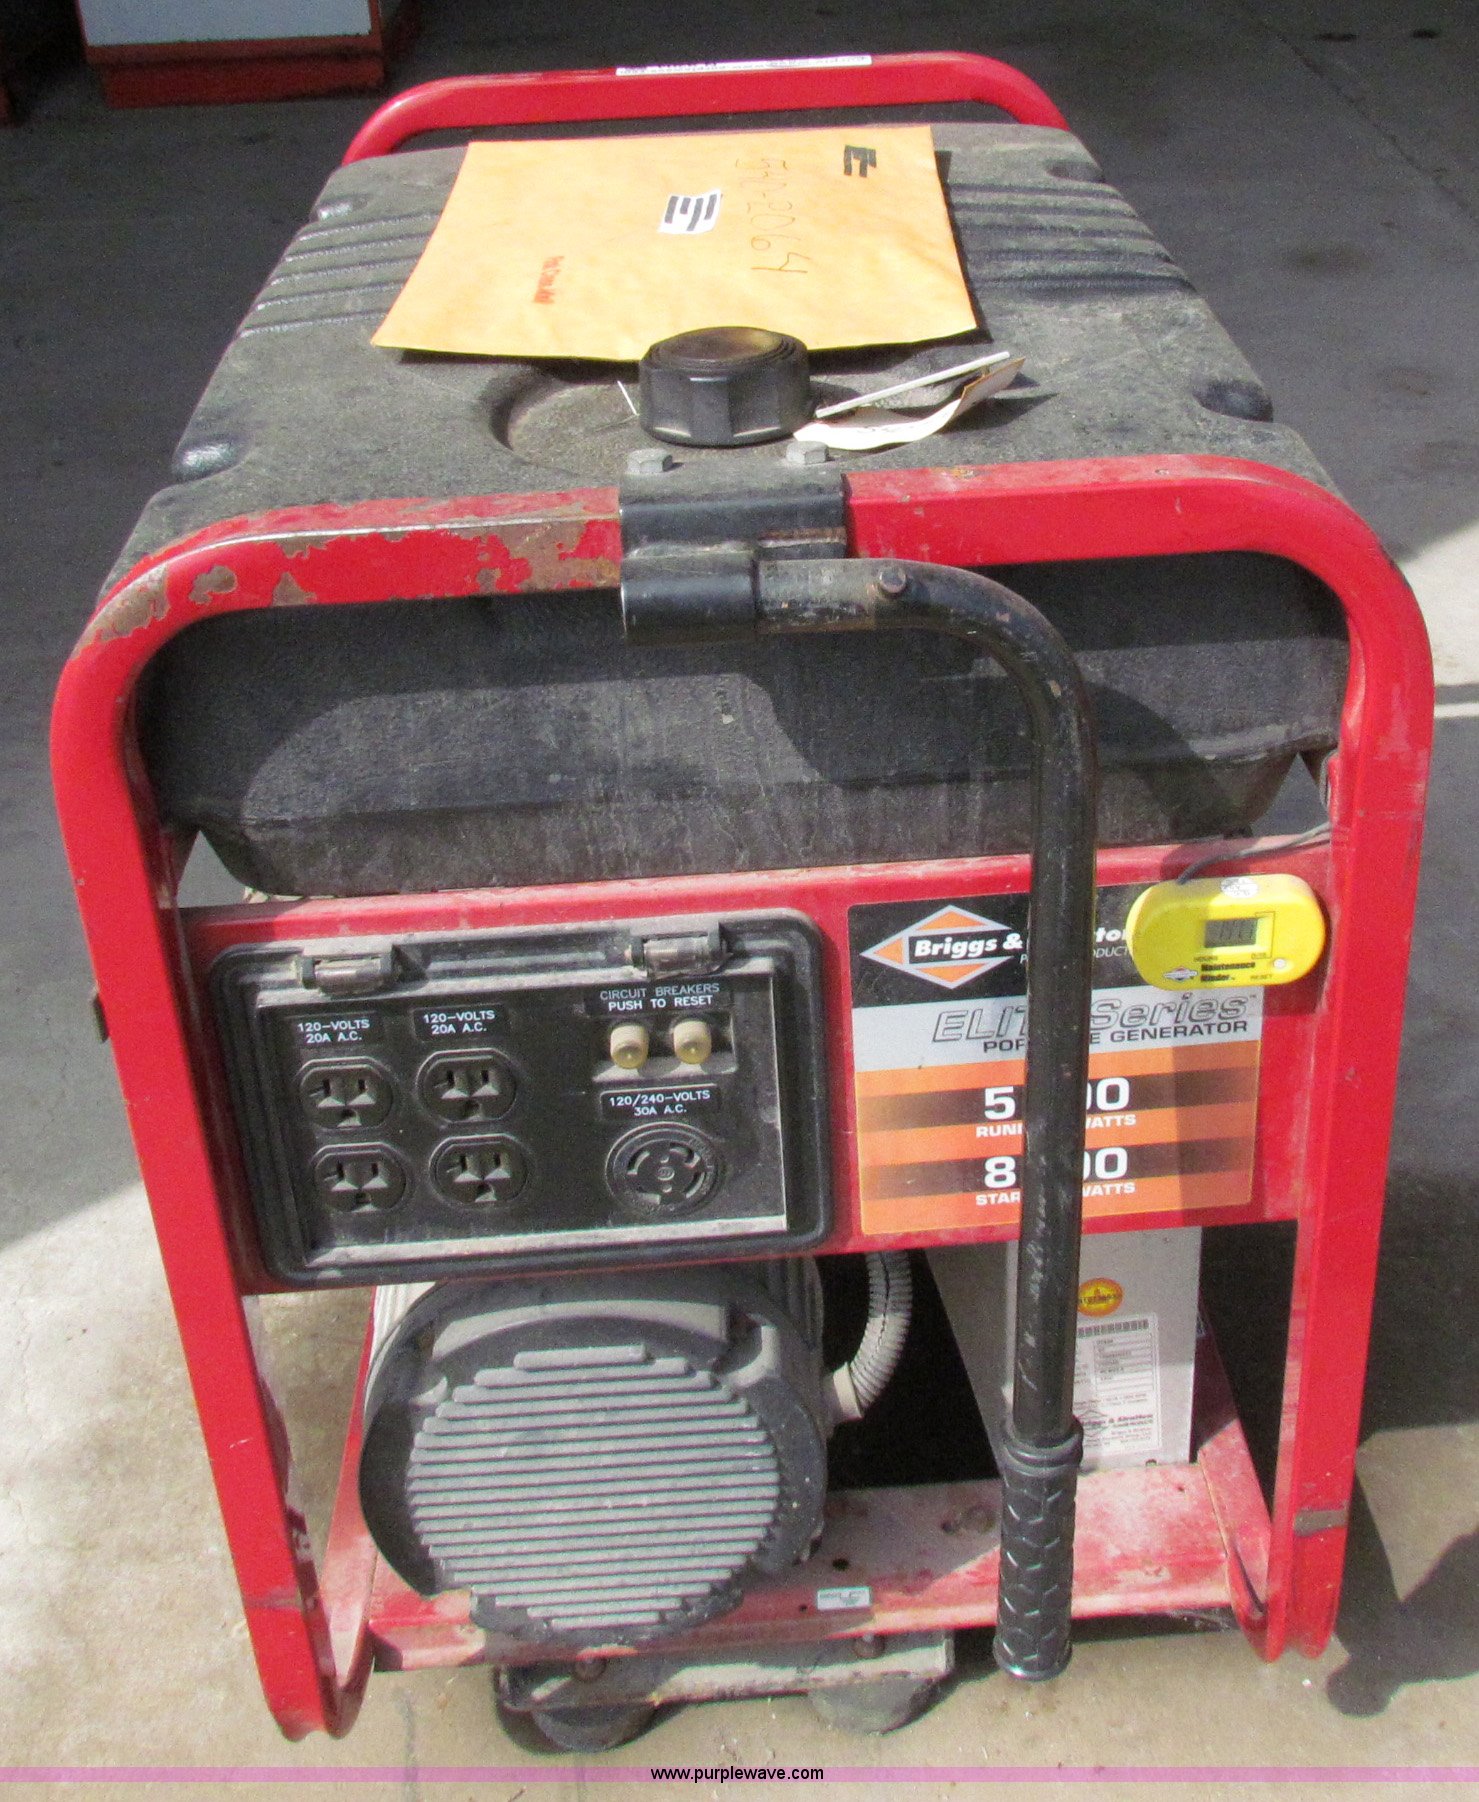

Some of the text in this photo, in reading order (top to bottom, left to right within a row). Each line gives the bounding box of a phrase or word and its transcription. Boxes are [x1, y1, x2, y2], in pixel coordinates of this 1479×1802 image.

[914, 937, 998, 959] Briggs
[1002, 932, 1024, 950] &
[600, 982, 720, 1001] CIRCUIT BREAKERS
[608, 995, 713, 1012] PUSH TO RESET
[1091, 992, 1249, 1031] Series
[423, 1010, 497, 1024] 120-VOLTS
[297, 1019, 371, 1033] 120-VOLTS
[431, 1021, 488, 1035] 20A A.C.
[1110, 1020, 1248, 1043] GENERATOR
[306, 1031, 362, 1044] 20A A.C.
[609, 1090, 711, 1107] 120/240-VOLTS
[634, 1103, 687, 1117] 30A A.C.
